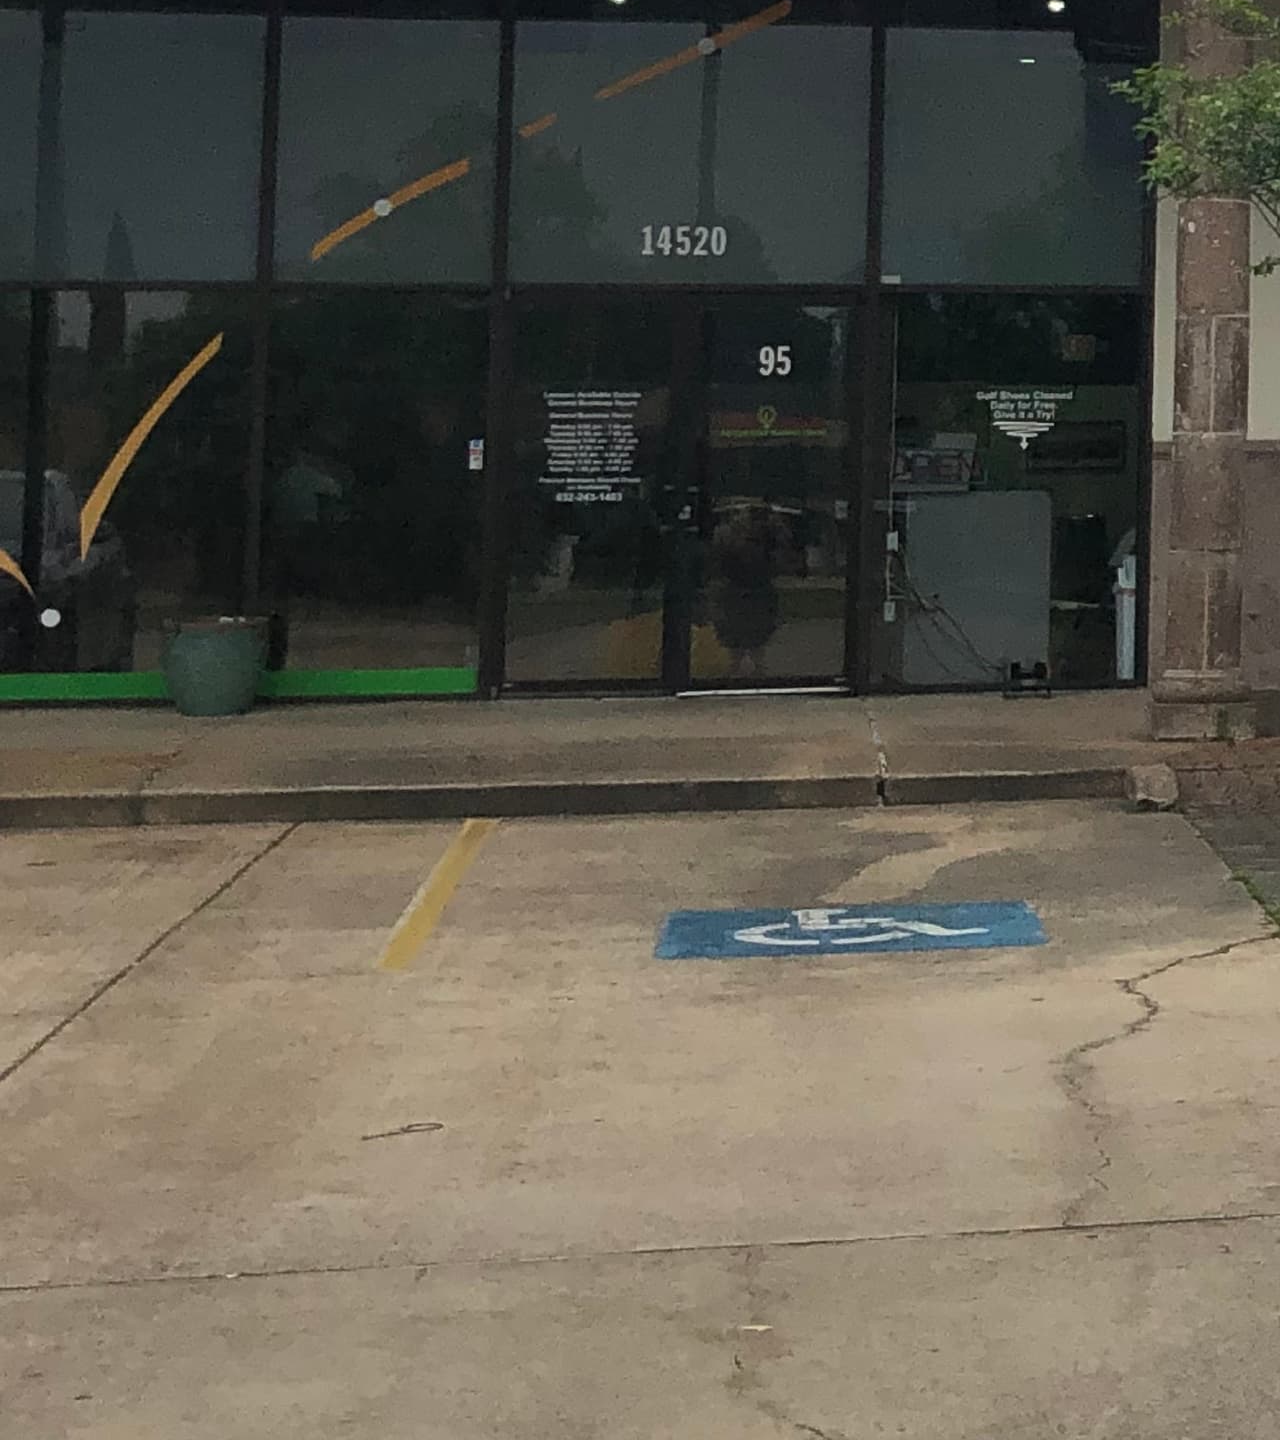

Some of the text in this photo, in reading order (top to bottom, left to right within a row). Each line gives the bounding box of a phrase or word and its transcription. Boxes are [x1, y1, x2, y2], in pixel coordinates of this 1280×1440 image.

[641, 224, 728, 256] 14520
[759, 344, 792, 376] 95
[976, 391, 998, 401] Golf
[1017, 400, 1032, 410] for
[993, 410, 1016, 419] Give
